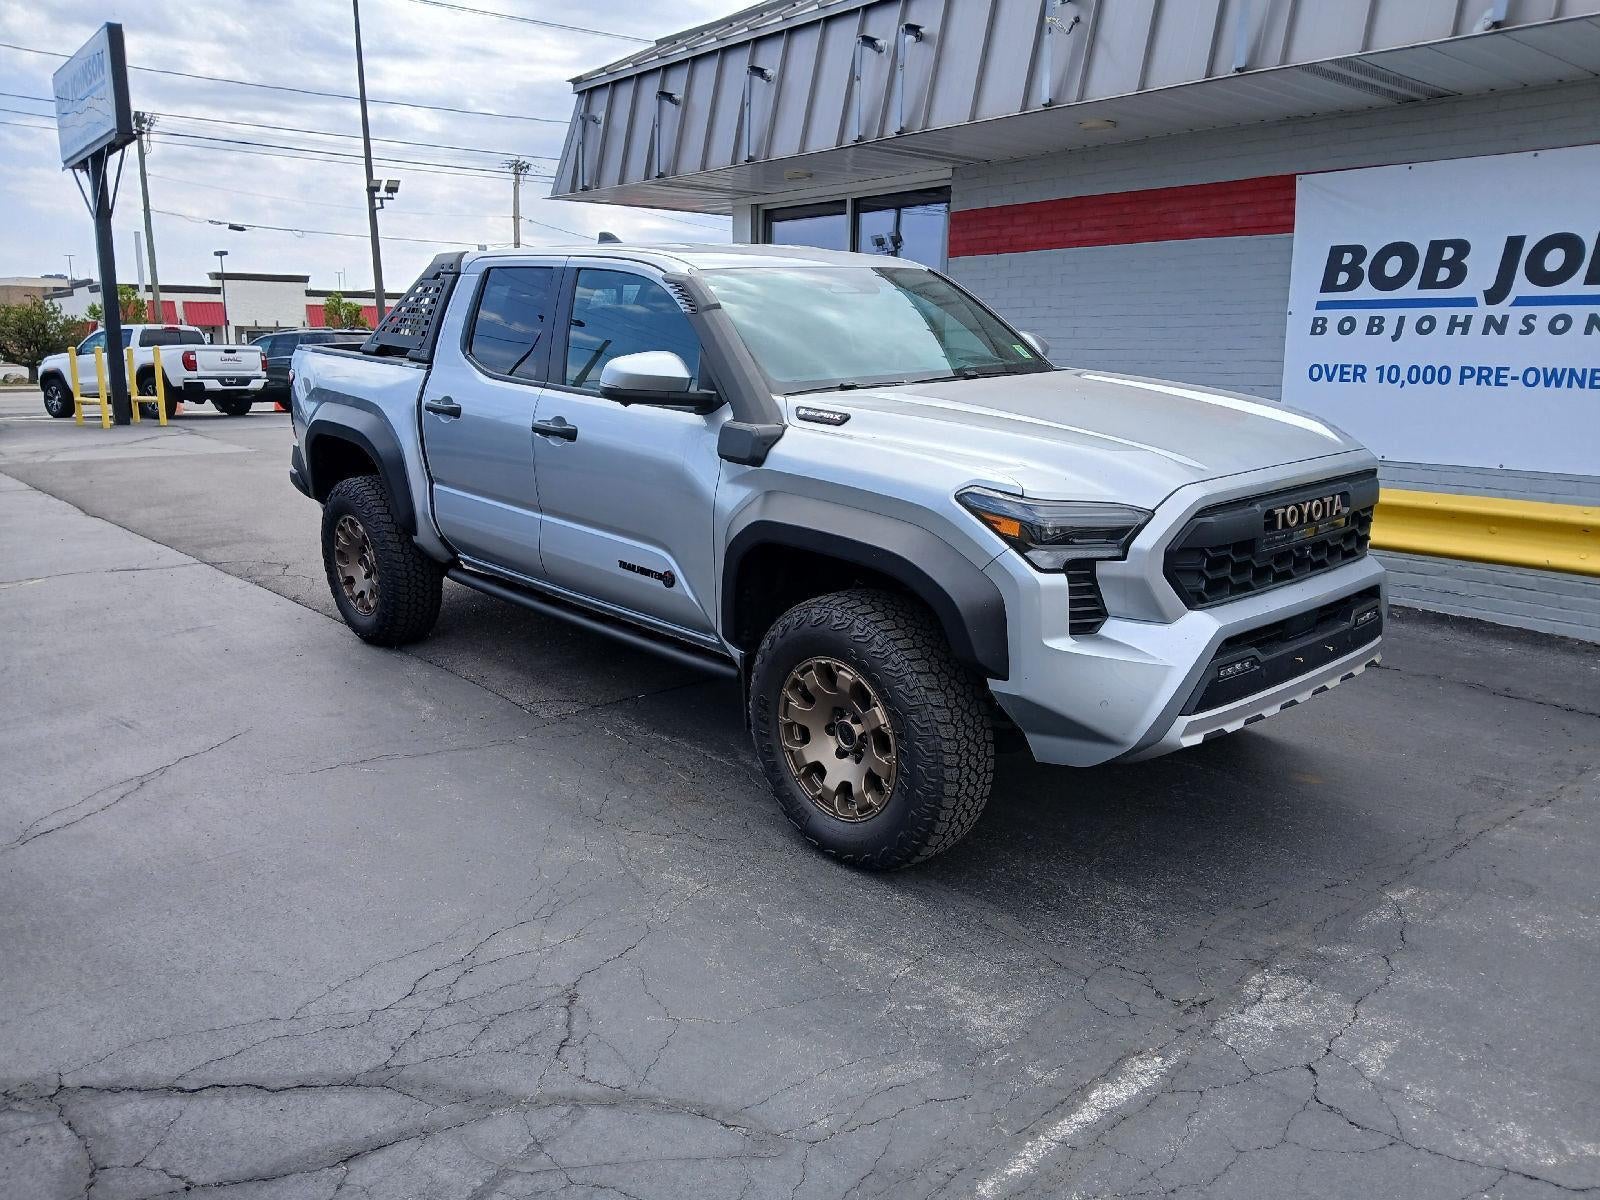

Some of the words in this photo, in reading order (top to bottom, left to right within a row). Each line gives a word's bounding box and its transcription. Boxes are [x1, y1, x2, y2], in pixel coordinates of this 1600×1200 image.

[1319, 238, 1472, 293] BOB
[1482, 231, 1600, 306] JO
[1308, 363, 1368, 384] OVER
[1375, 364, 1452, 389] 10,000
[1274, 494, 1344, 530] TOYOTA
